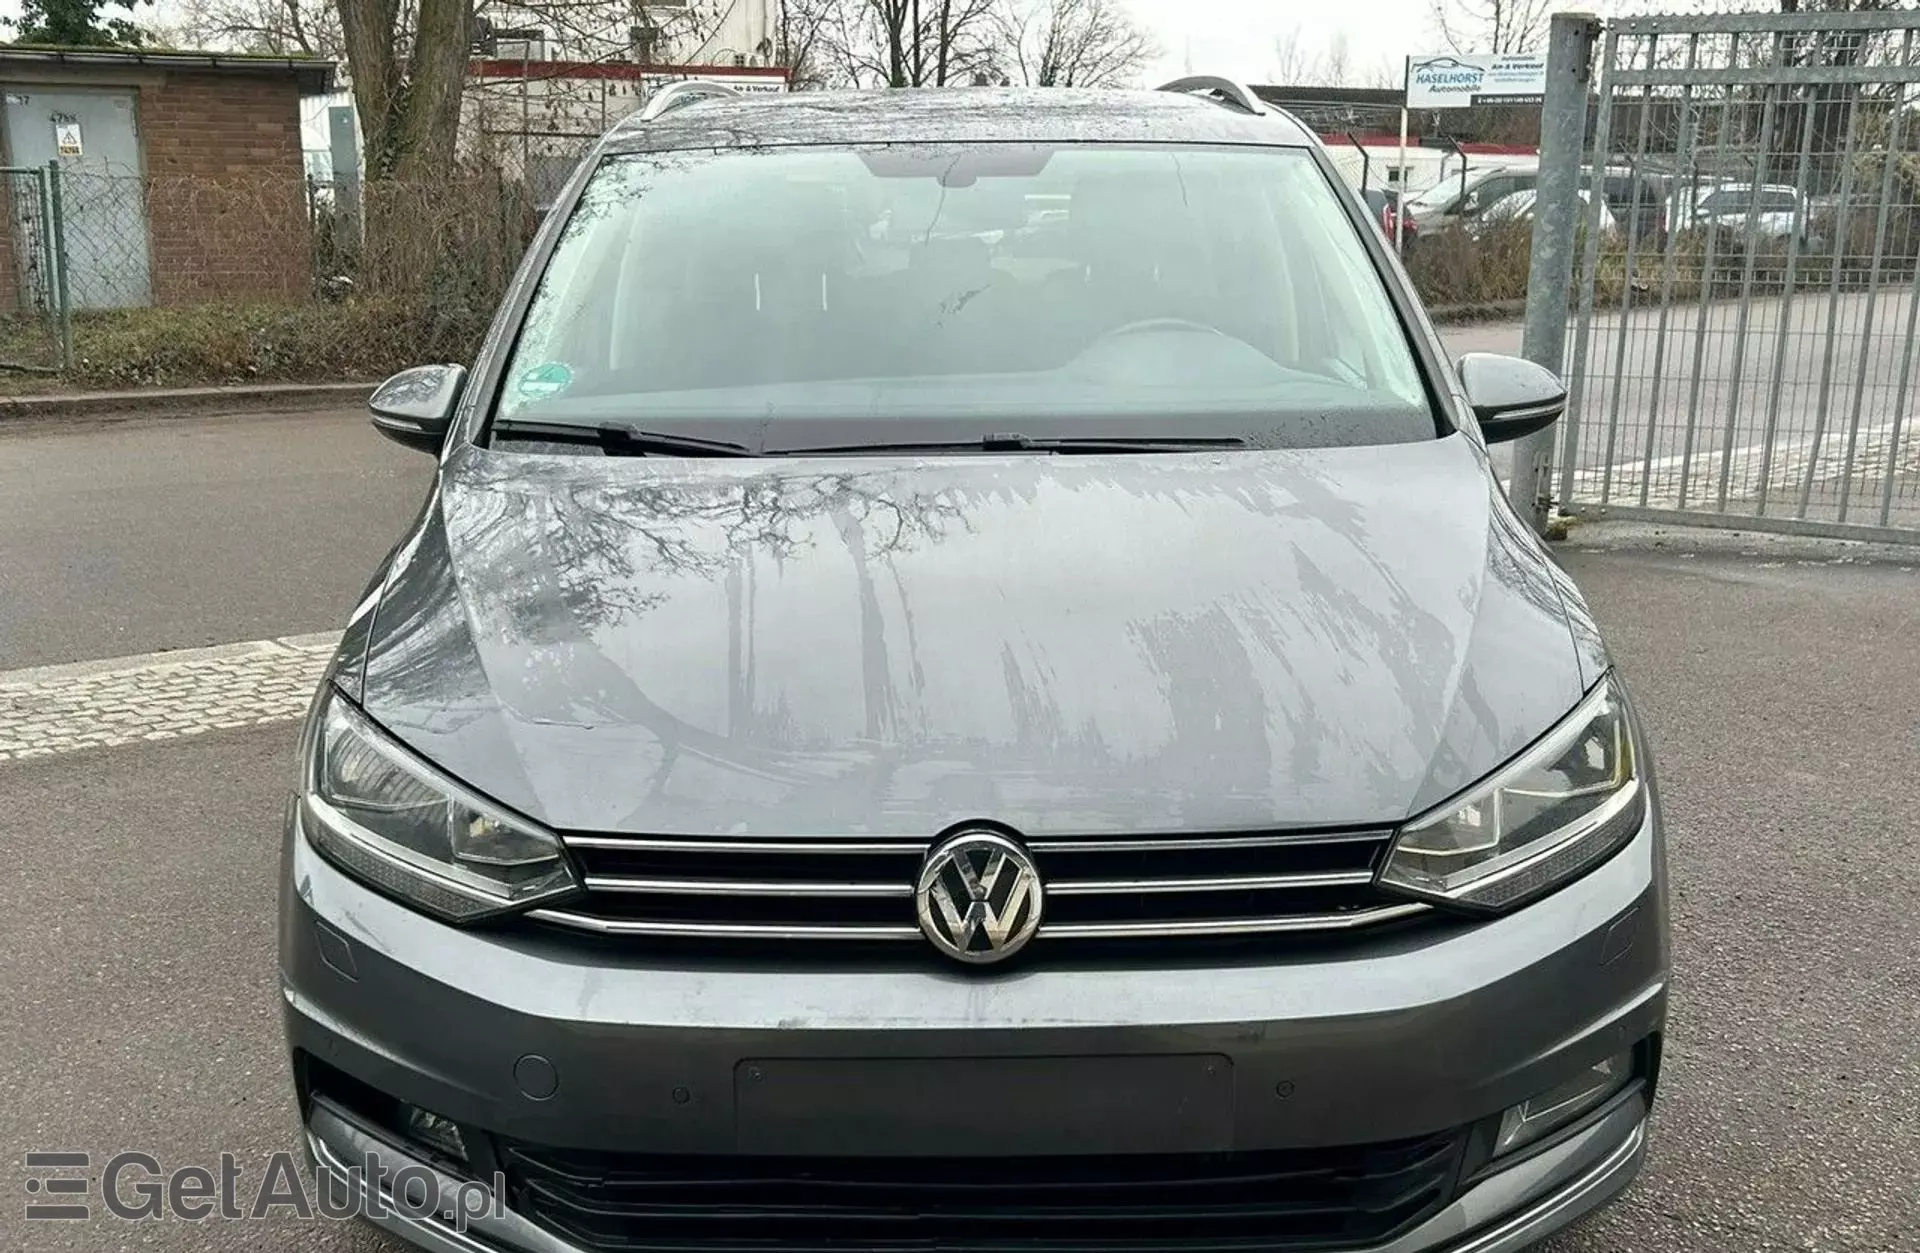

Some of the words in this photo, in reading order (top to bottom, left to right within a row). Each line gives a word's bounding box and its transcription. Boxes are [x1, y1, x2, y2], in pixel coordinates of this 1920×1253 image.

[1416, 72, 1484, 84] HASELHORST
[1428, 84, 1482, 93] Automobile
[924, 842, 1035, 957] VW
